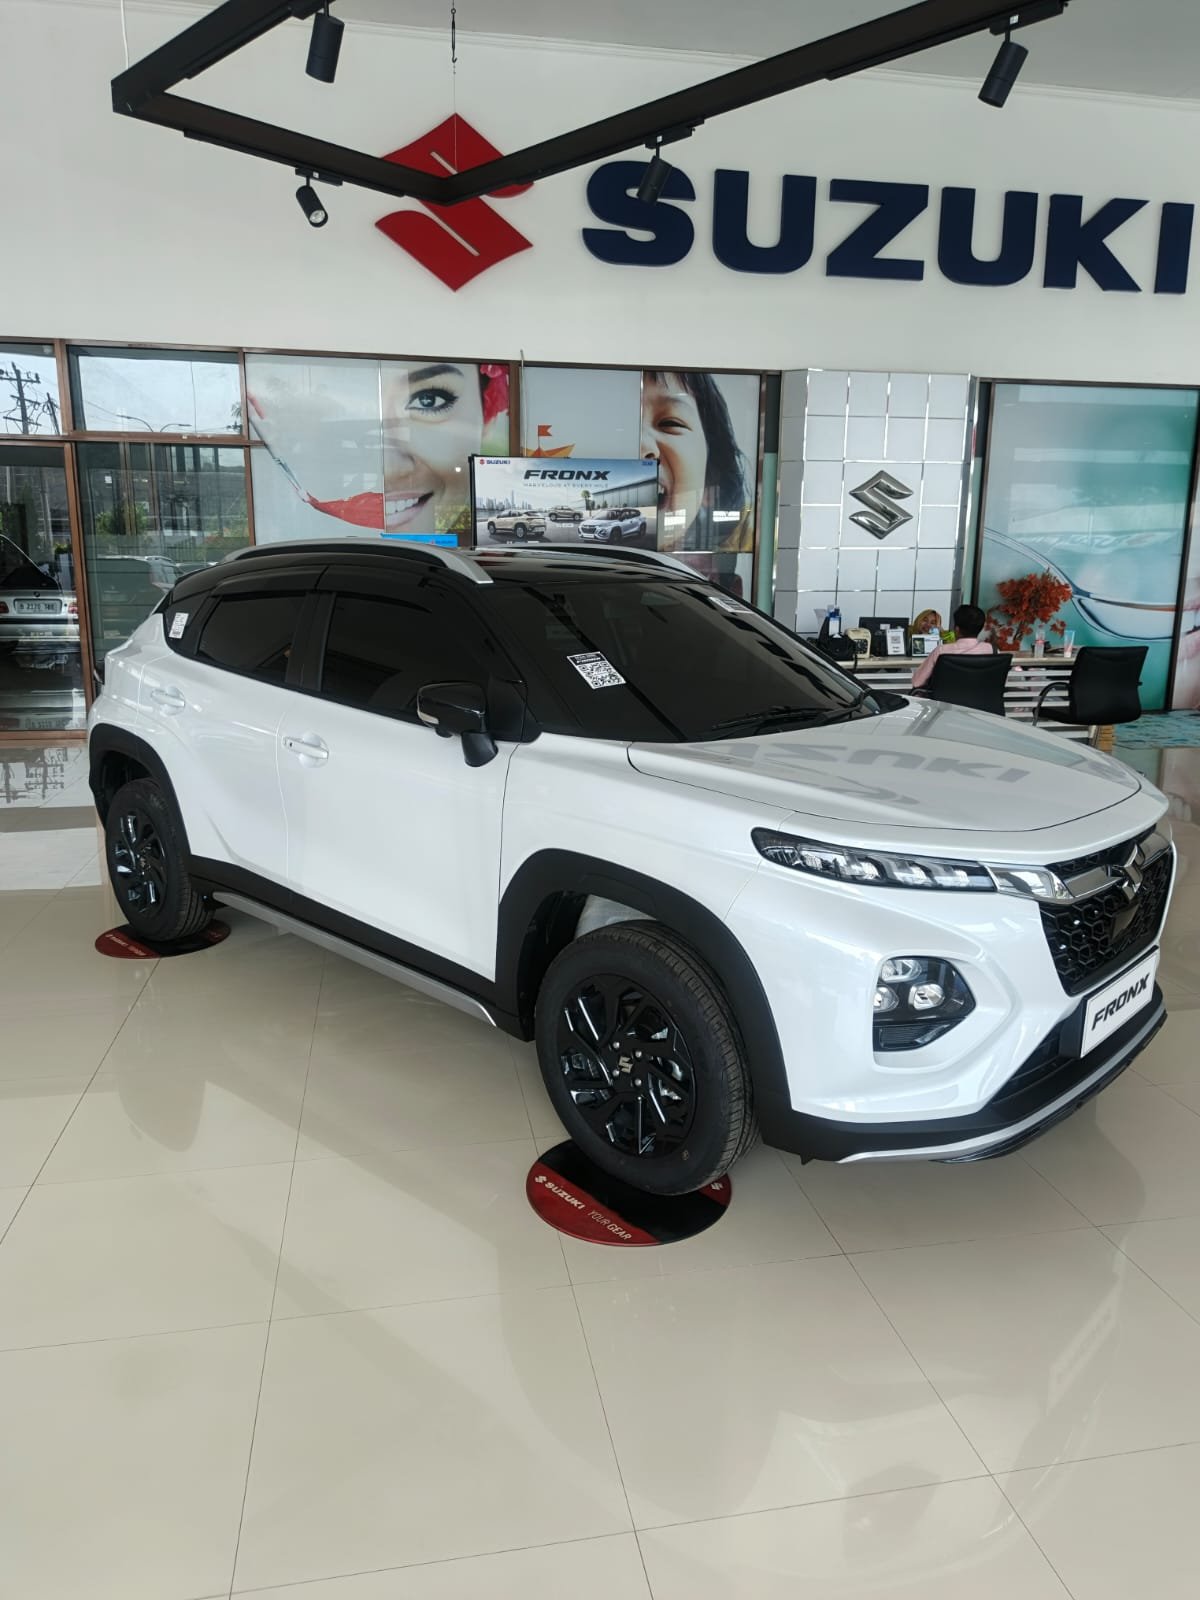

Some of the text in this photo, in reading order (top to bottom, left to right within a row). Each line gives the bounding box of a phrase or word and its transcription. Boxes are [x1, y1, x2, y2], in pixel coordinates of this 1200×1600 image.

[582, 160, 1194, 294] SUZUKI
[524, 470, 611, 481] FRONX
[1091, 972, 1150, 1031] FRONX
[545, 1181, 632, 1240] SUZUKI YOUR GEAR
